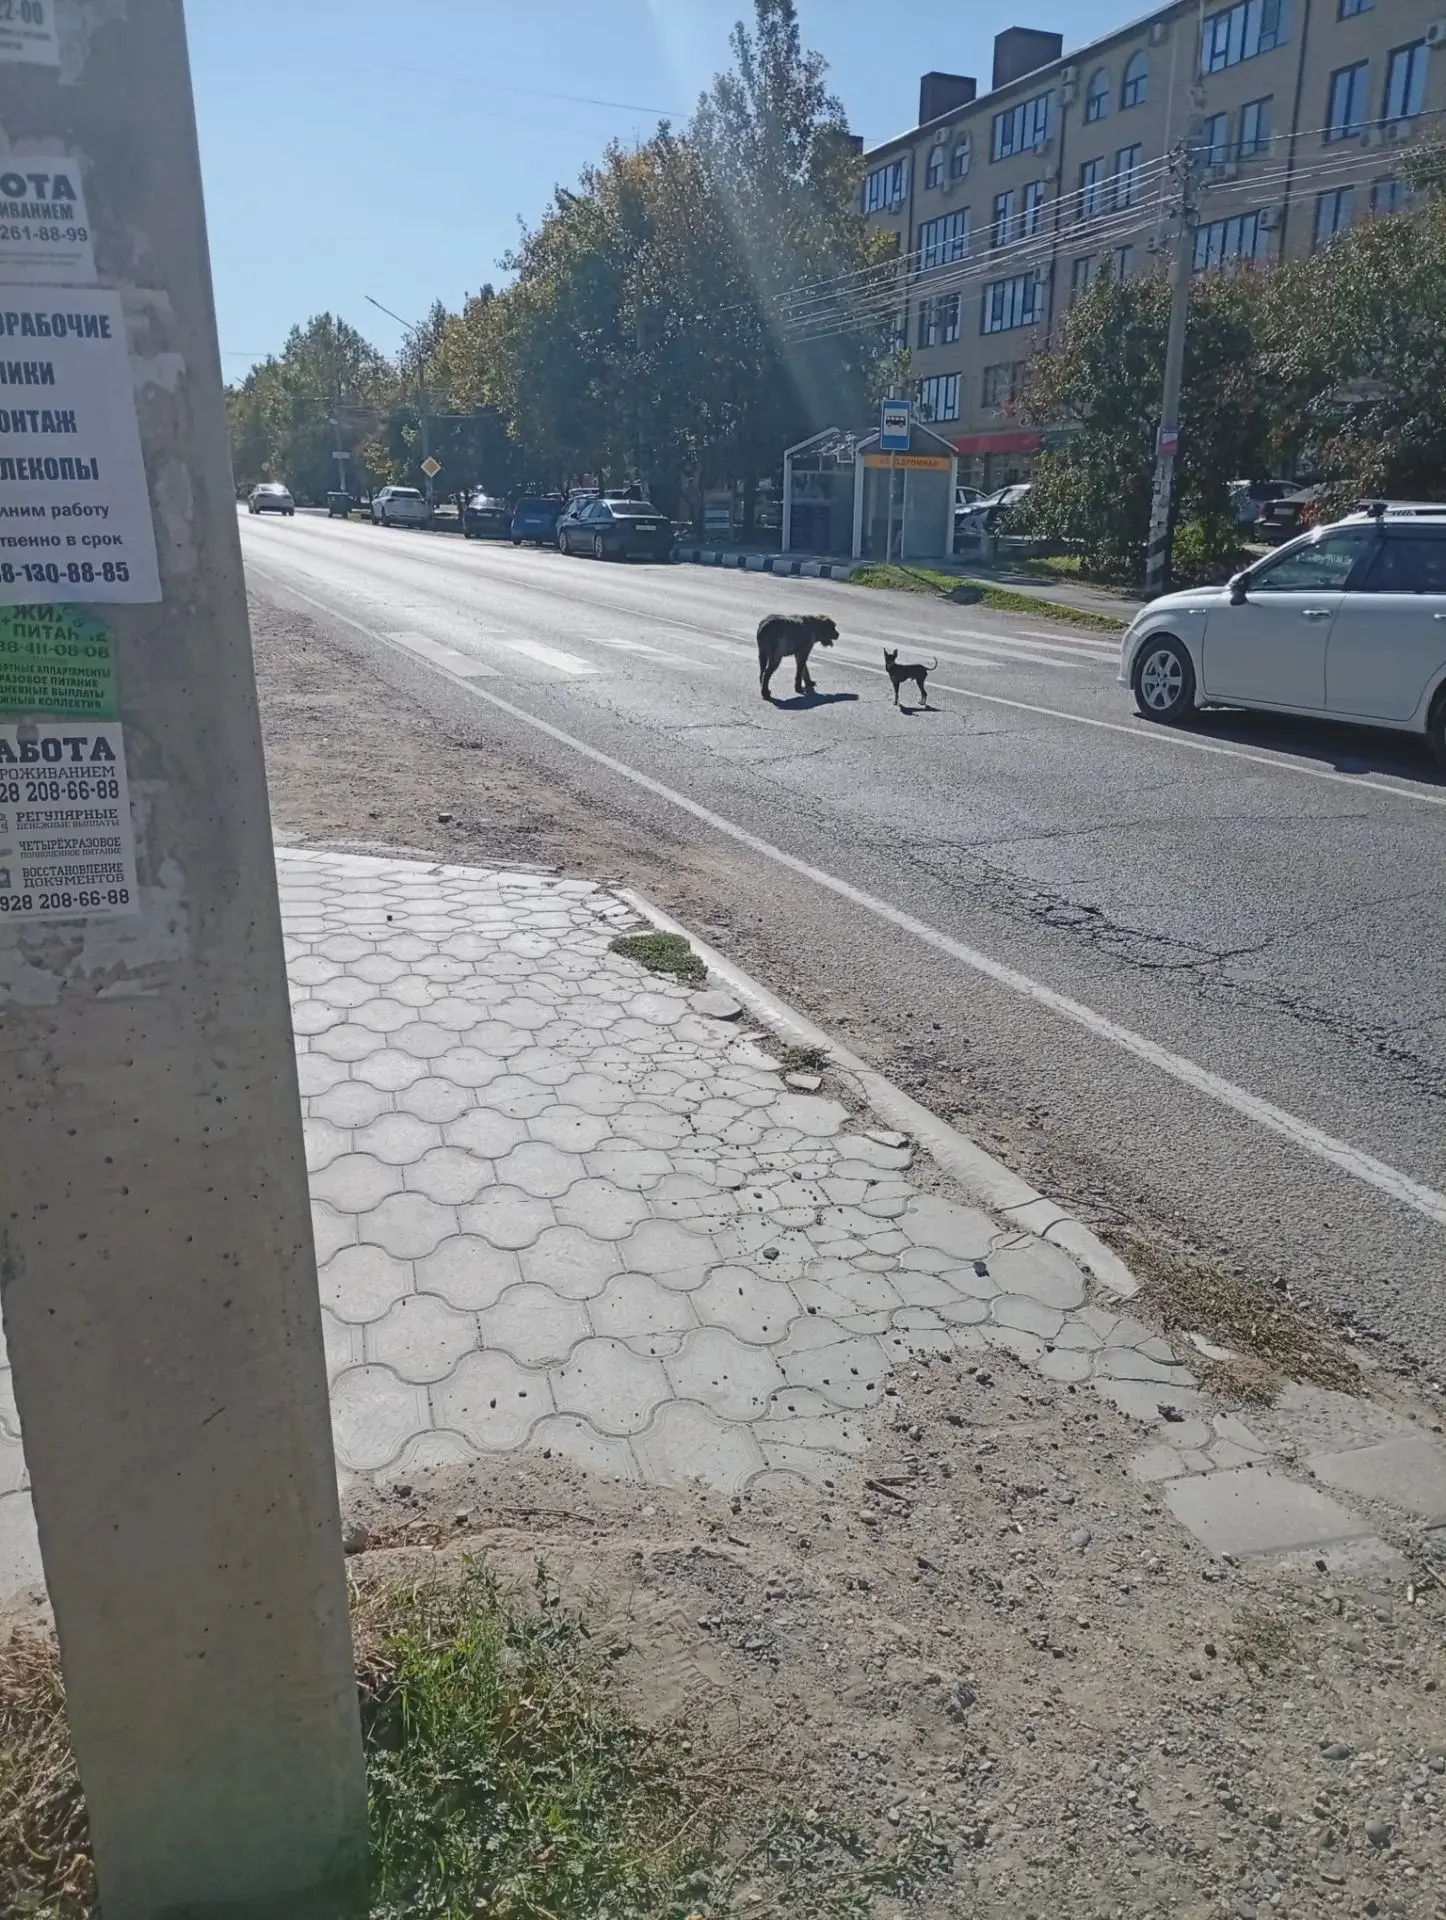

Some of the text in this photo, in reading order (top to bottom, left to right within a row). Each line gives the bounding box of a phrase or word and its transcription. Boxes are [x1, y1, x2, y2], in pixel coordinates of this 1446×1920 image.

[0, 0, 43, 25] 2-00
[0, 171, 77, 200] ОТА
[0, 225, 88, 242] 261-88-99
[0, 409, 77, 433] ОНТАЖ
[0, 457, 100, 481] ЛЕКОПЫ
[51, 502, 109, 519] работу
[66, 536, 77, 546] в
[82, 534, 123, 548] срок
[0, 562, 130, 583] 8-130-88-85
[0, 766, 115, 780] РОЖИВАНИЕМ
[25, 780, 119, 802] 208-66-88
[16, 808, 118, 822] РЕГУЛЯРНЫЕ
[22, 862, 124, 878] ВОССТАНОВЛЕНИЕ
[24, 873, 124, 889] ДОКУМЕНТОВ
[0, 888, 130, 911] 928 208-66-88
